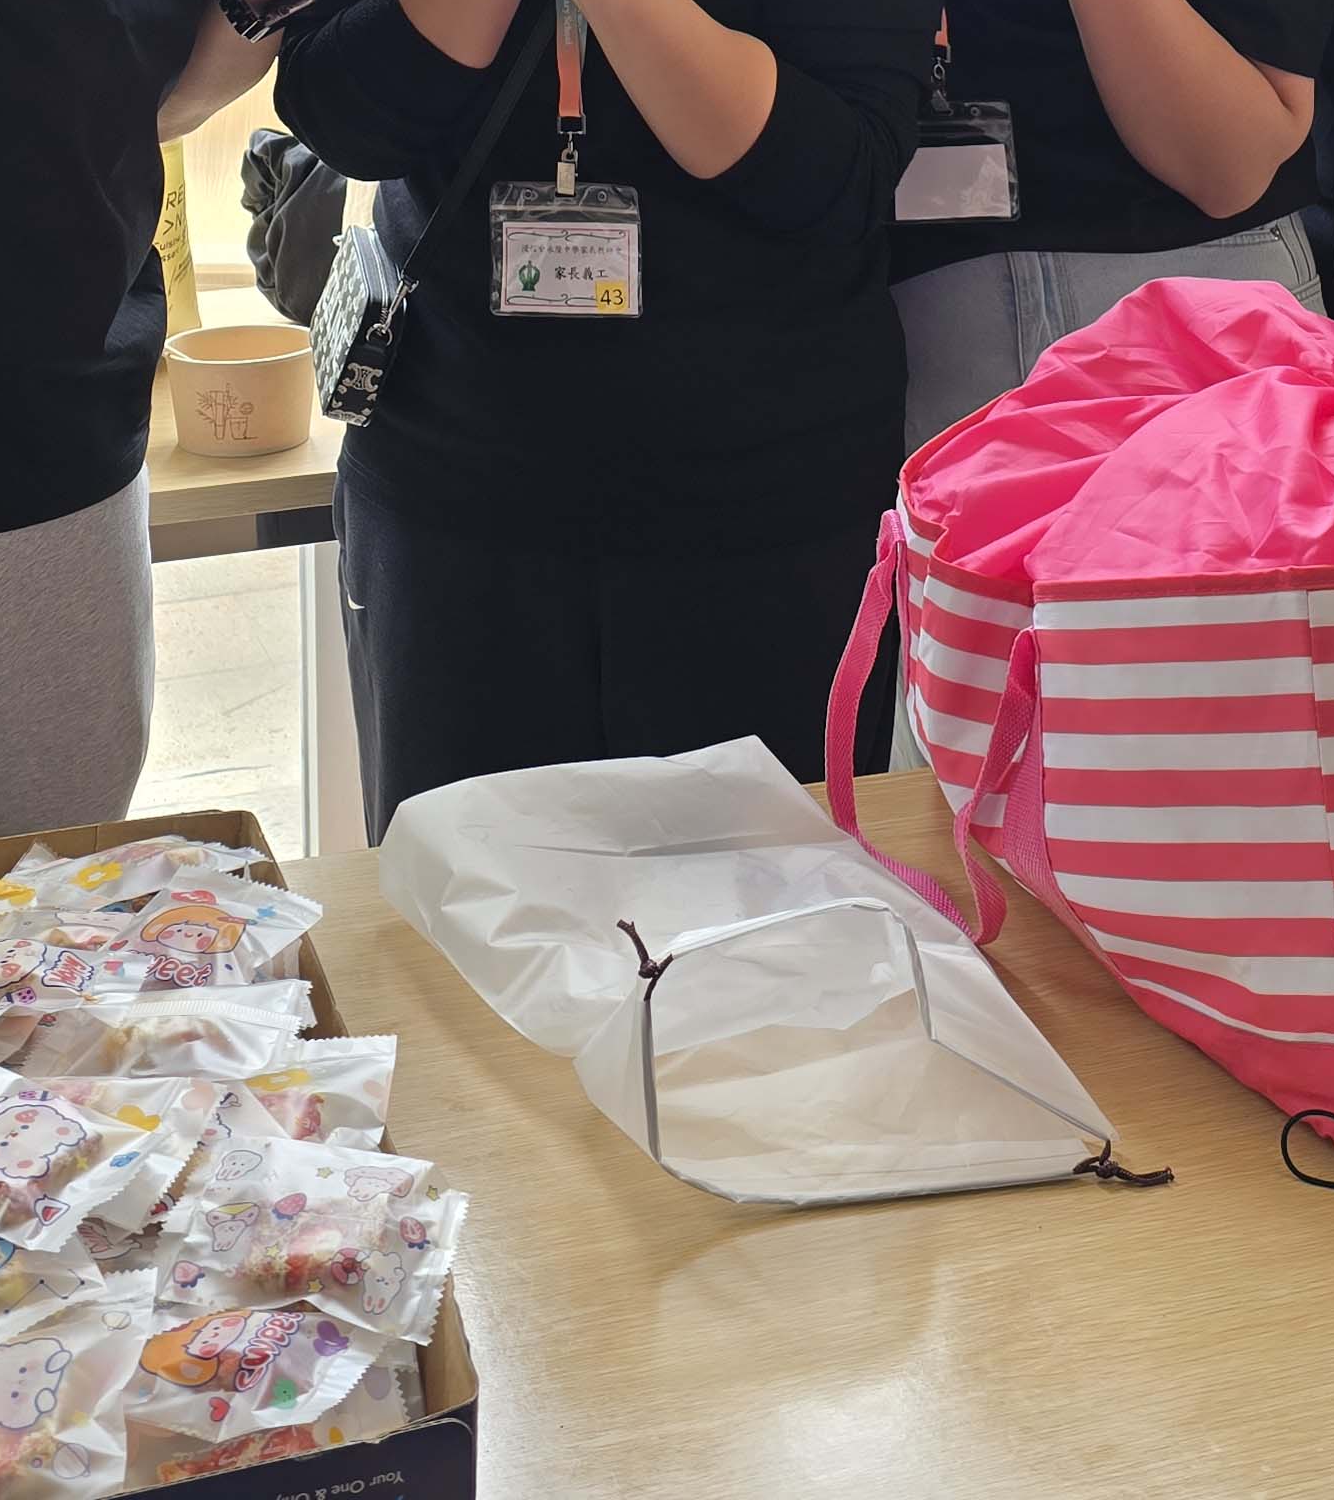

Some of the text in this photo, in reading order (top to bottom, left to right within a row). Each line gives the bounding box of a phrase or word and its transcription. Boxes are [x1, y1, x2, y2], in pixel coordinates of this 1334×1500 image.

[554, 265, 609, 281] 家長義工
[600, 289, 624, 306] 43
[330, 1479, 365, 1494] One
[369, 1470, 404, 1487] Your
